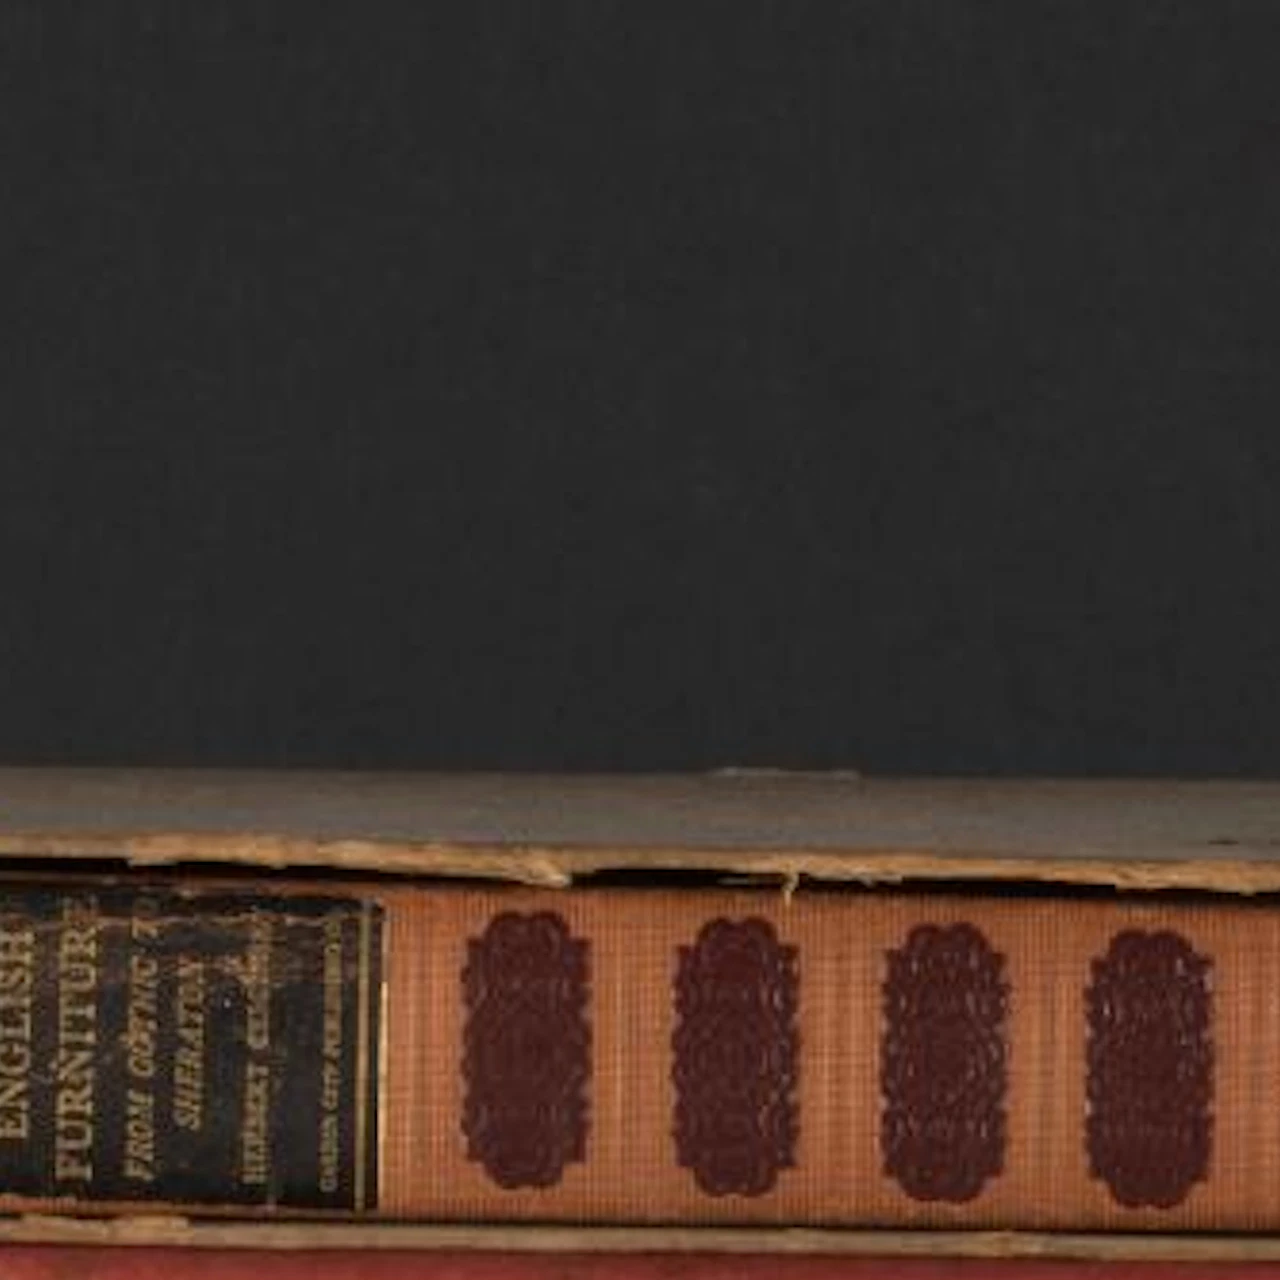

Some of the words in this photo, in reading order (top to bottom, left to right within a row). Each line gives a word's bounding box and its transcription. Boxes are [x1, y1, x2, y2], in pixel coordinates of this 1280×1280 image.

[55, 896, 99, 1182] FURNITURE
[126, 954, 160, 1078] GOTHIC
[172, 957, 206, 1132] SHERATON
[124, 1089, 157, 1183] FROM
